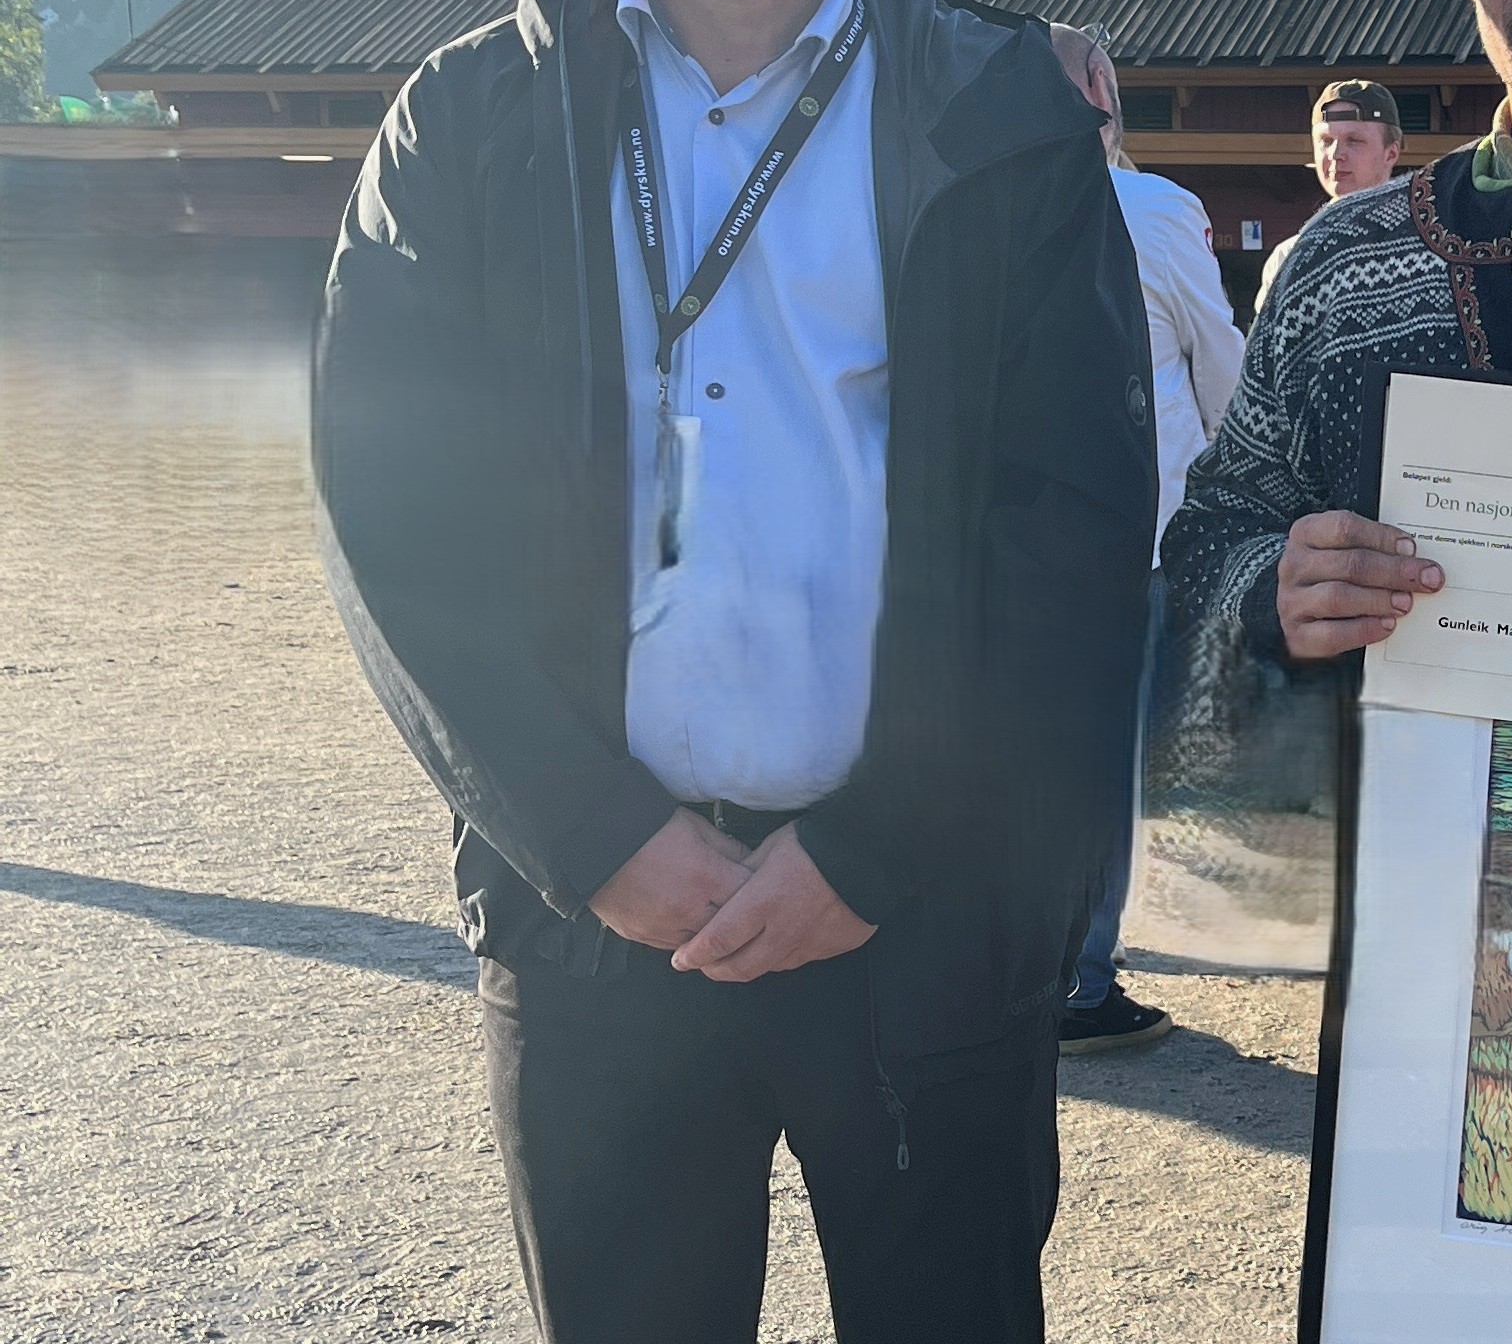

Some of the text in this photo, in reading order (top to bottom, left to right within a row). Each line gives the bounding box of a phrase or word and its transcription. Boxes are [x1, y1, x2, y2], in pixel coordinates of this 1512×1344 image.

[630, 128, 656, 247] www.dyrskun.no
[718, 151, 784, 256] www.dyrskun.no
[1425, 492, 1460, 511] Den
[1438, 616, 1489, 634] Gunleik
